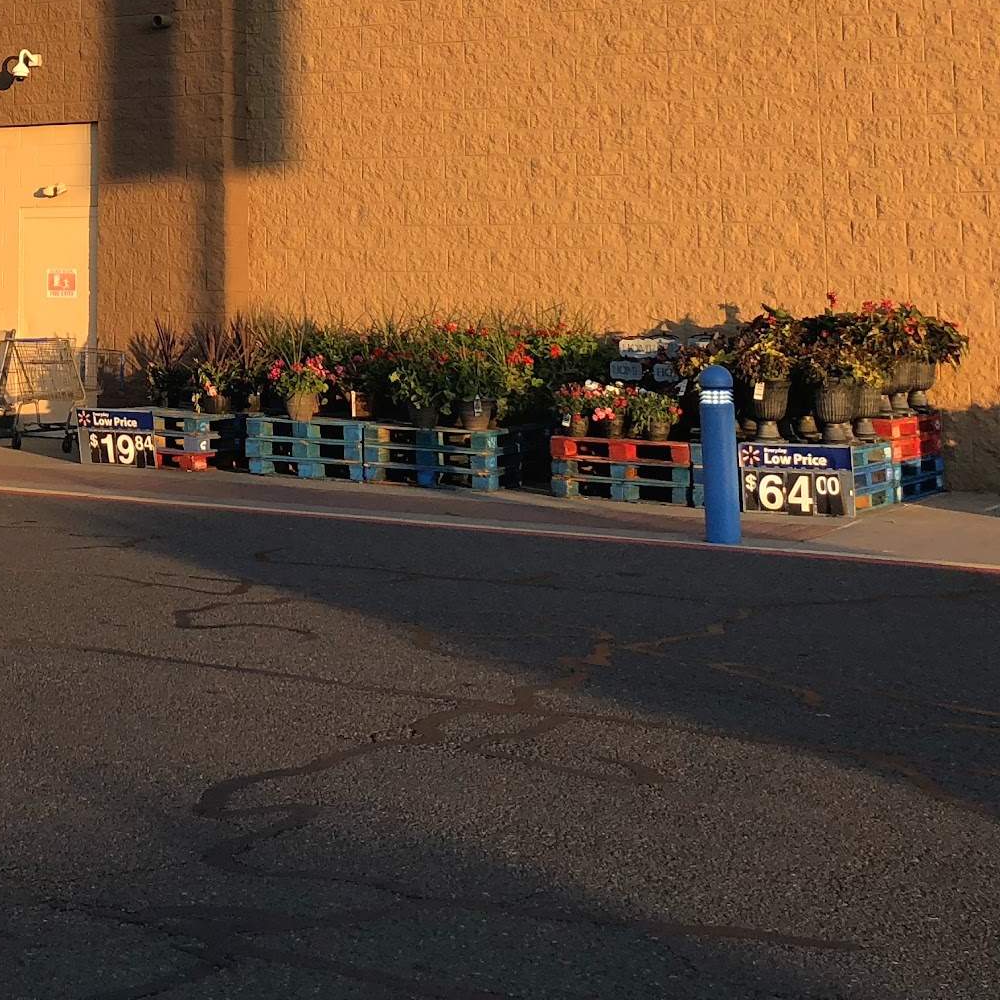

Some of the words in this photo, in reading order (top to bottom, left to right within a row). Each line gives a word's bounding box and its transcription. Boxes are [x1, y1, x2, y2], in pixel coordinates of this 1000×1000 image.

[93, 415, 112, 427] Low
[114, 417, 138, 428] Price
[764, 452, 792, 464] Low
[793, 453, 828, 466] Price
